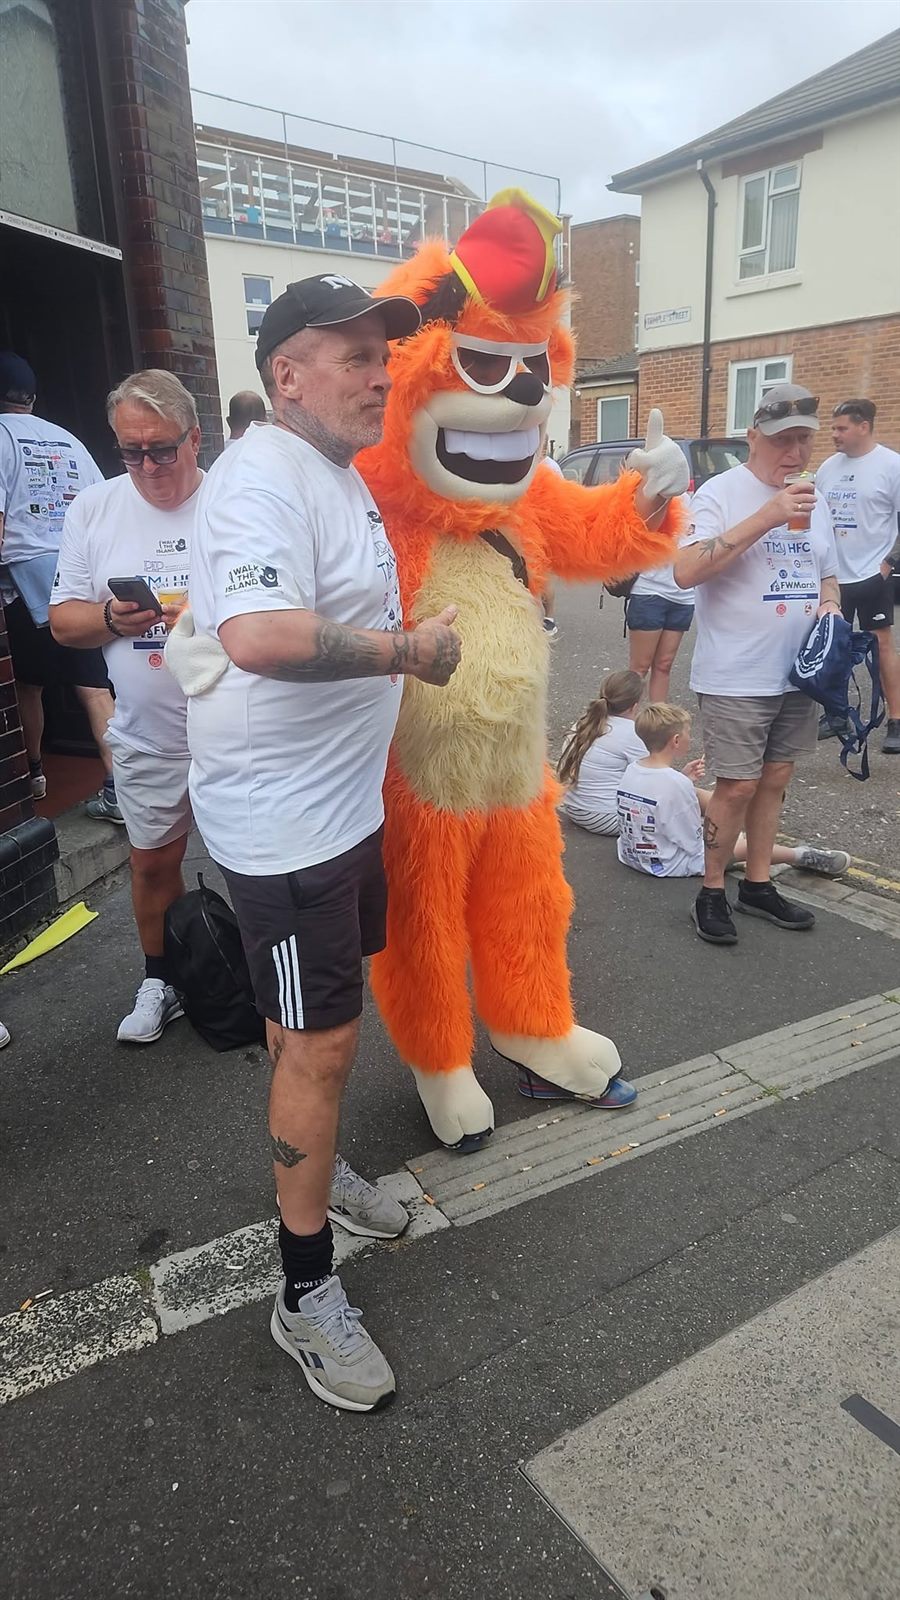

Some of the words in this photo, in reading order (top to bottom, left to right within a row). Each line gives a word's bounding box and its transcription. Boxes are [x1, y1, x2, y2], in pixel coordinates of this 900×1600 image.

[233, 564, 260, 576] WALK
[237, 571, 255, 582] THE
[225, 578, 259, 593] ISLAND
